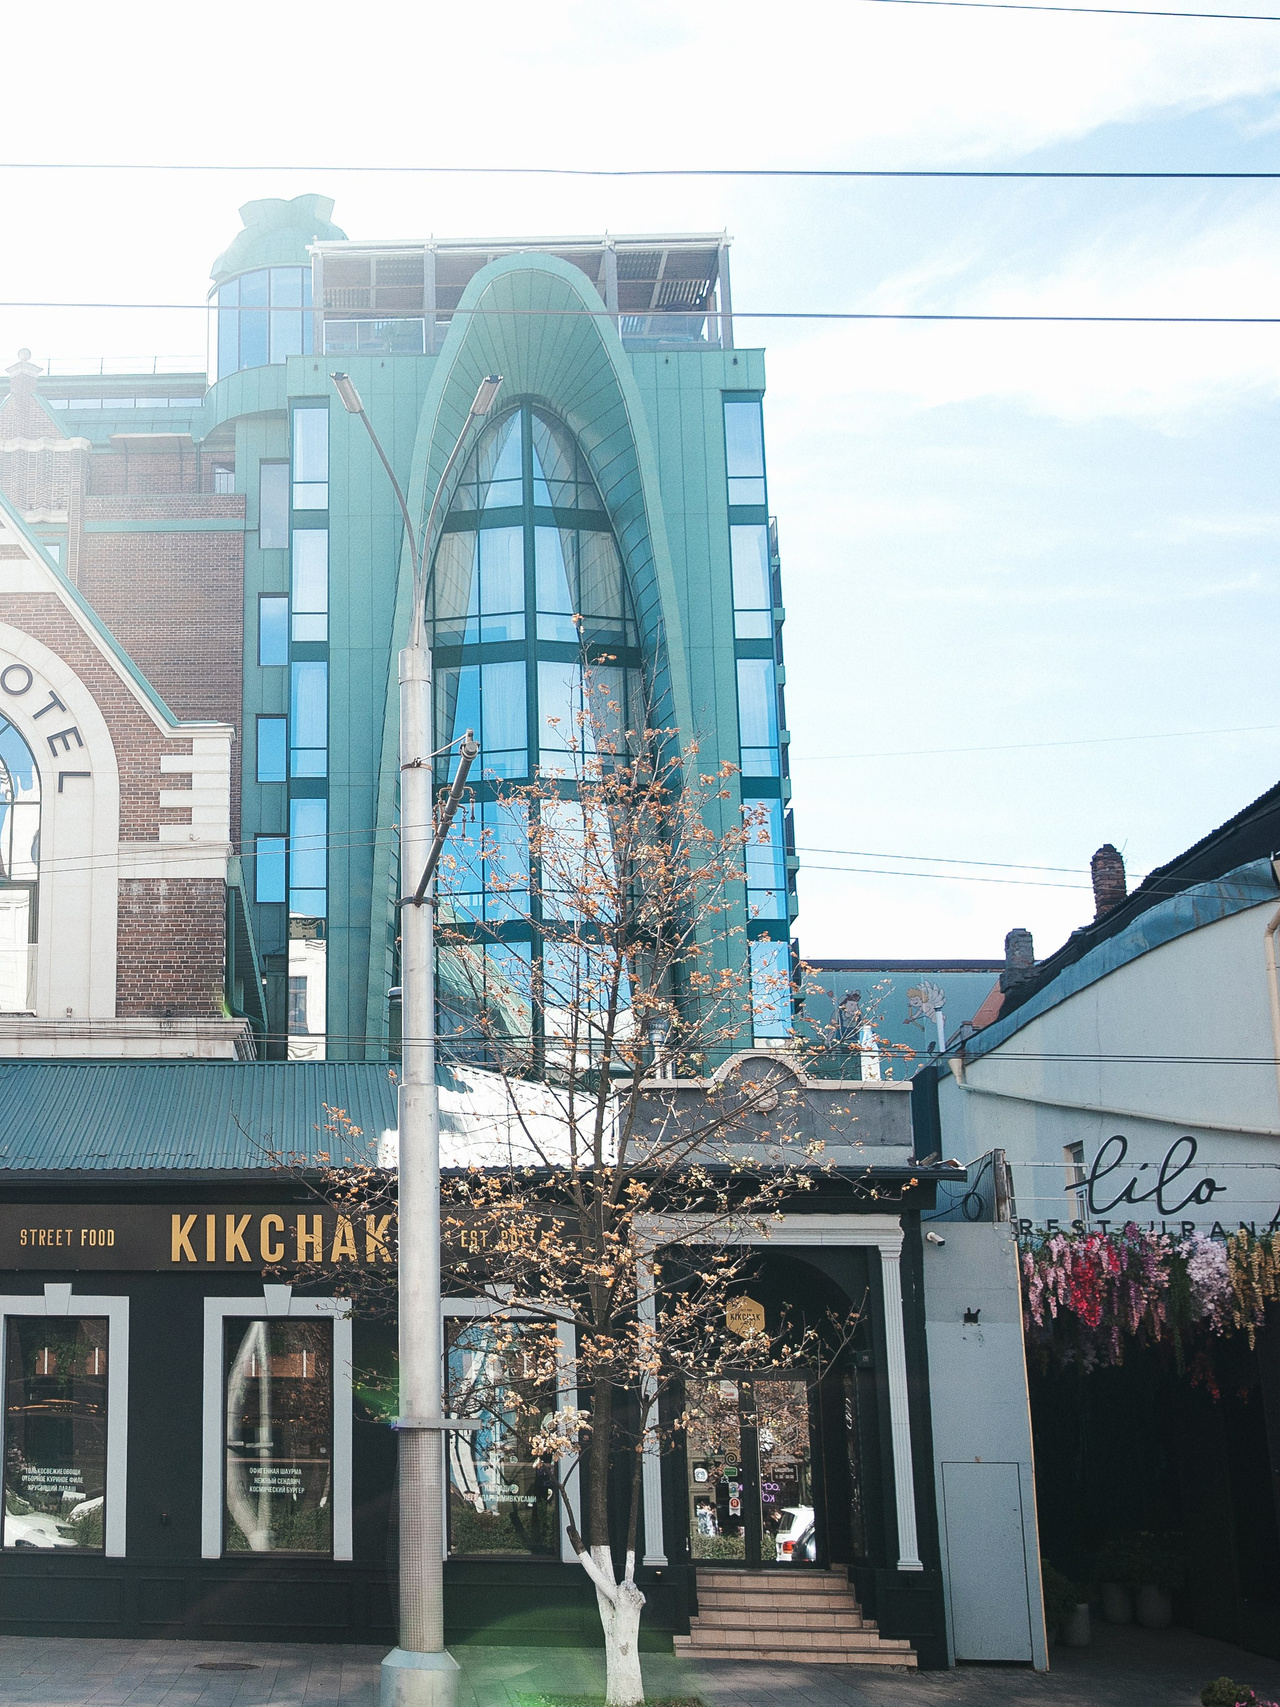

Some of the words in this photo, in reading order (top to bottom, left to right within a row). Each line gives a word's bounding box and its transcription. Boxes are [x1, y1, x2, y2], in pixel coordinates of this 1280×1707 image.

[1063, 1134, 1227, 1216] lilo
[19, 1228, 73, 1247] STREET
[80, 1229, 116, 1247] FOOD
